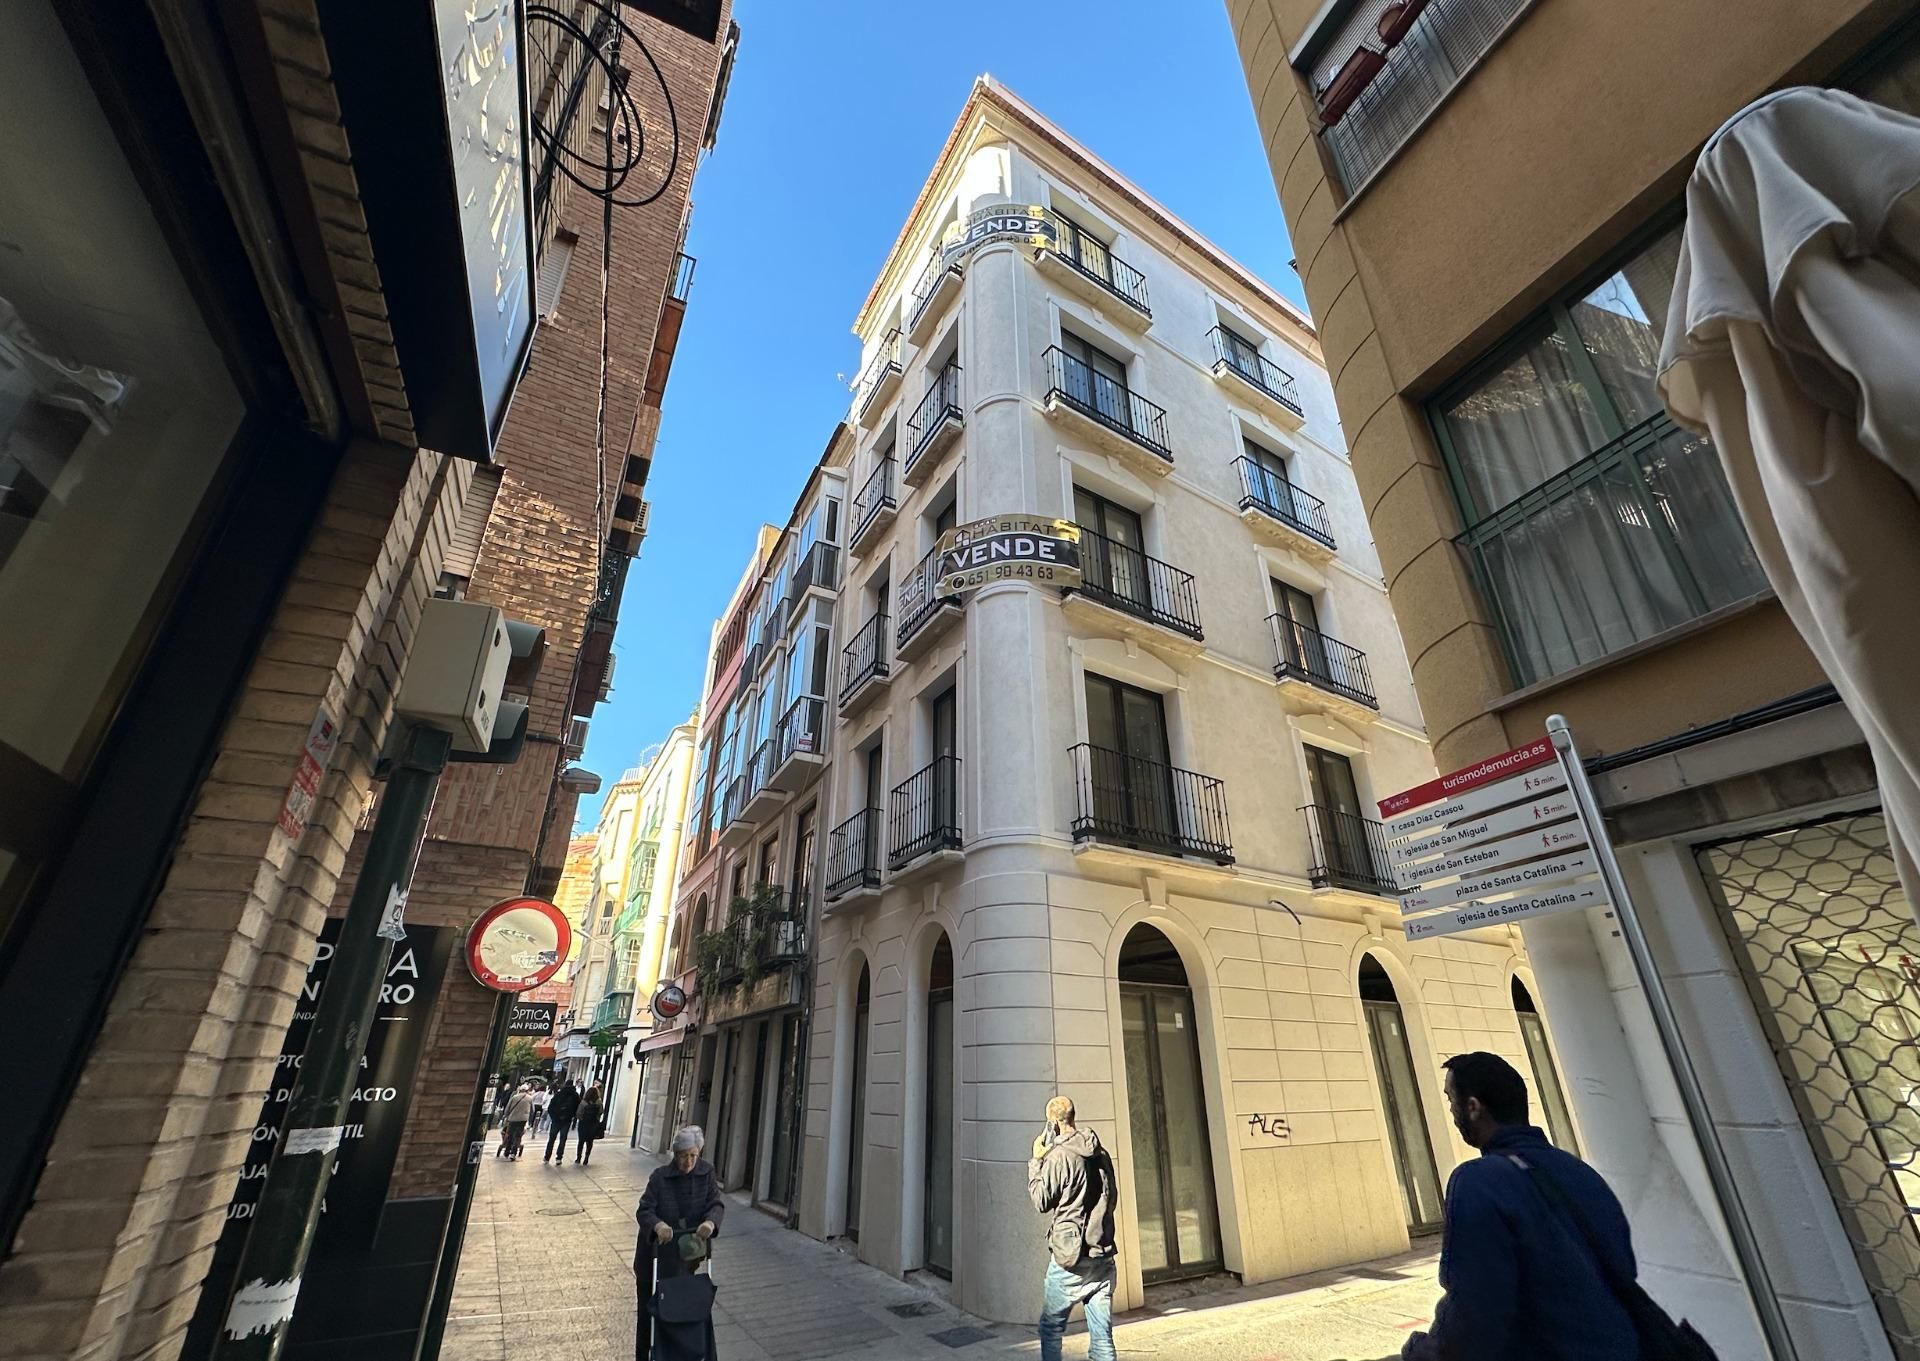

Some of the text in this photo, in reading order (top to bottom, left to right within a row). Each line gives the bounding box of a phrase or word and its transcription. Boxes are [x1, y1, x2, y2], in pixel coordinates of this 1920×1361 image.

[973, 521, 1054, 539] HABITAT
[952, 538, 1056, 568] VENDE
[968, 565, 1054, 585] 651 90 43 63
[900, 578, 924, 611] ENDE
[1442, 743, 1546, 790] turismodemurcia.es
[1533, 777, 1540, 786] 5
[1398, 819, 1415, 831] casa
[1434, 803, 1464, 818] Cassou
[1543, 806, 1550, 815] 5
[1404, 823, 1488, 857] iglesia de San Miguel
[1552, 834, 1559, 843] 5
[1409, 849, 1500, 880] iglesia de San Esteban
[1456, 863, 1567, 897] plaza de Santa Catalina
[1456, 894, 1576, 925] iglesia de Santa Catalina
[524, 1022, 550, 1030] PEDRO
